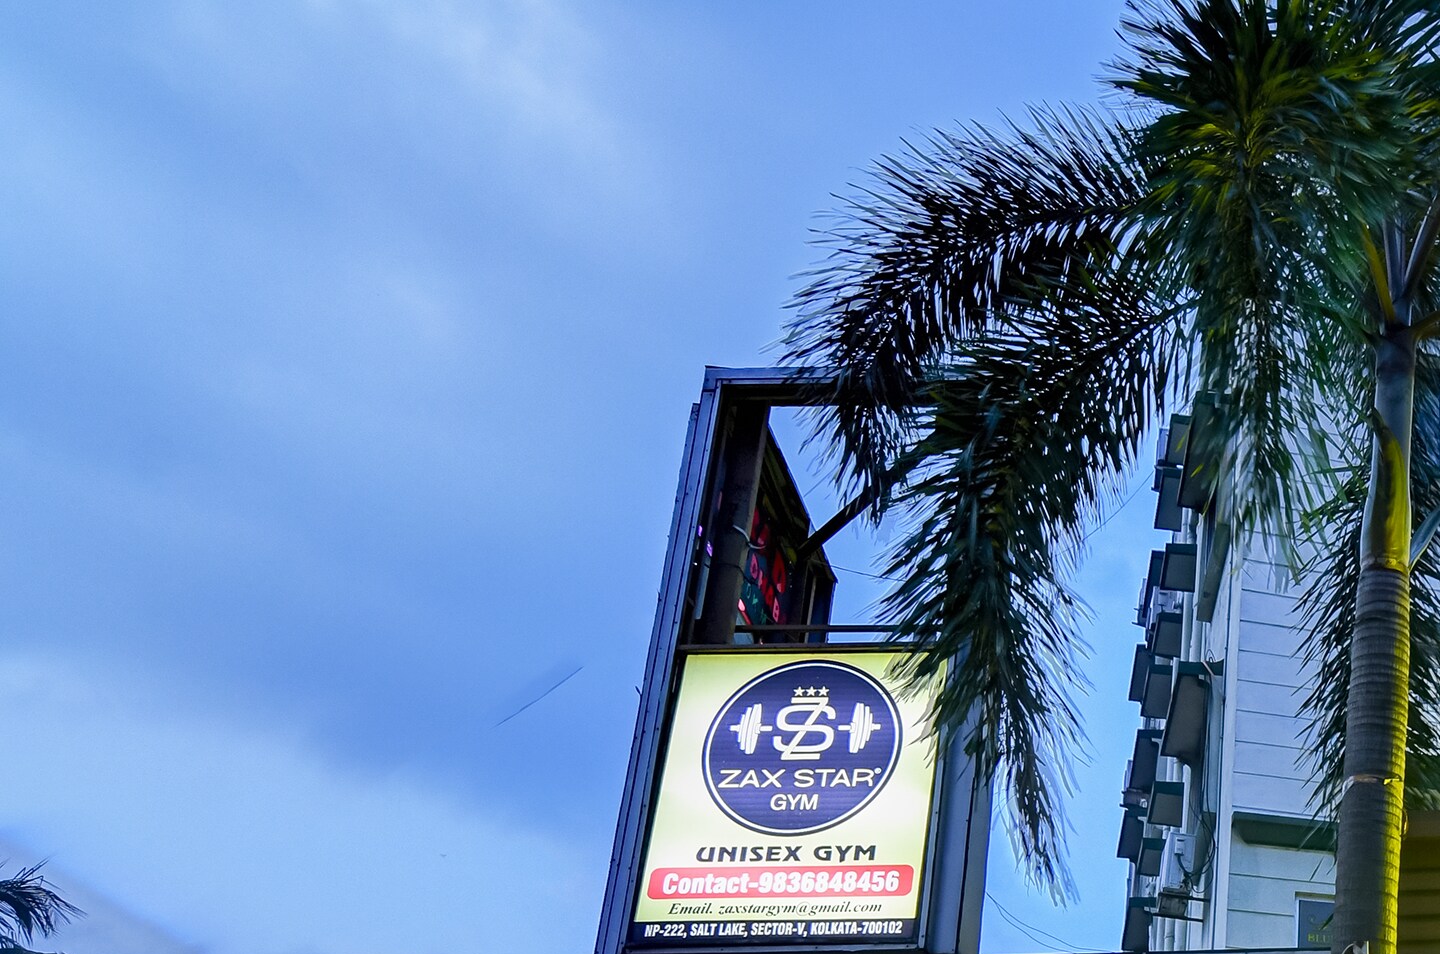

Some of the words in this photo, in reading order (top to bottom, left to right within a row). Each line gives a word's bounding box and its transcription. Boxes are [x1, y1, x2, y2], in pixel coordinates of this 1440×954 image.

[719, 768, 785, 788] ZAX
[794, 767, 875, 787] STAR
[770, 794, 818, 811] GYM
[696, 846, 803, 862] UNISEX
[814, 845, 876, 862] GYM
[662, 870, 900, 895] Contact-9836848456
[668, 902, 713, 915] Email.
[718, 902, 882, 917] zaxstargym@gmail.com
[644, 923, 687, 938] NP-222,
[690, 922, 716, 937] SALT
[716, 922, 747, 938] LAKE,
[751, 922, 807, 938] SECTOR-V,
[810, 921, 902, 937] KOLKATA-700102
